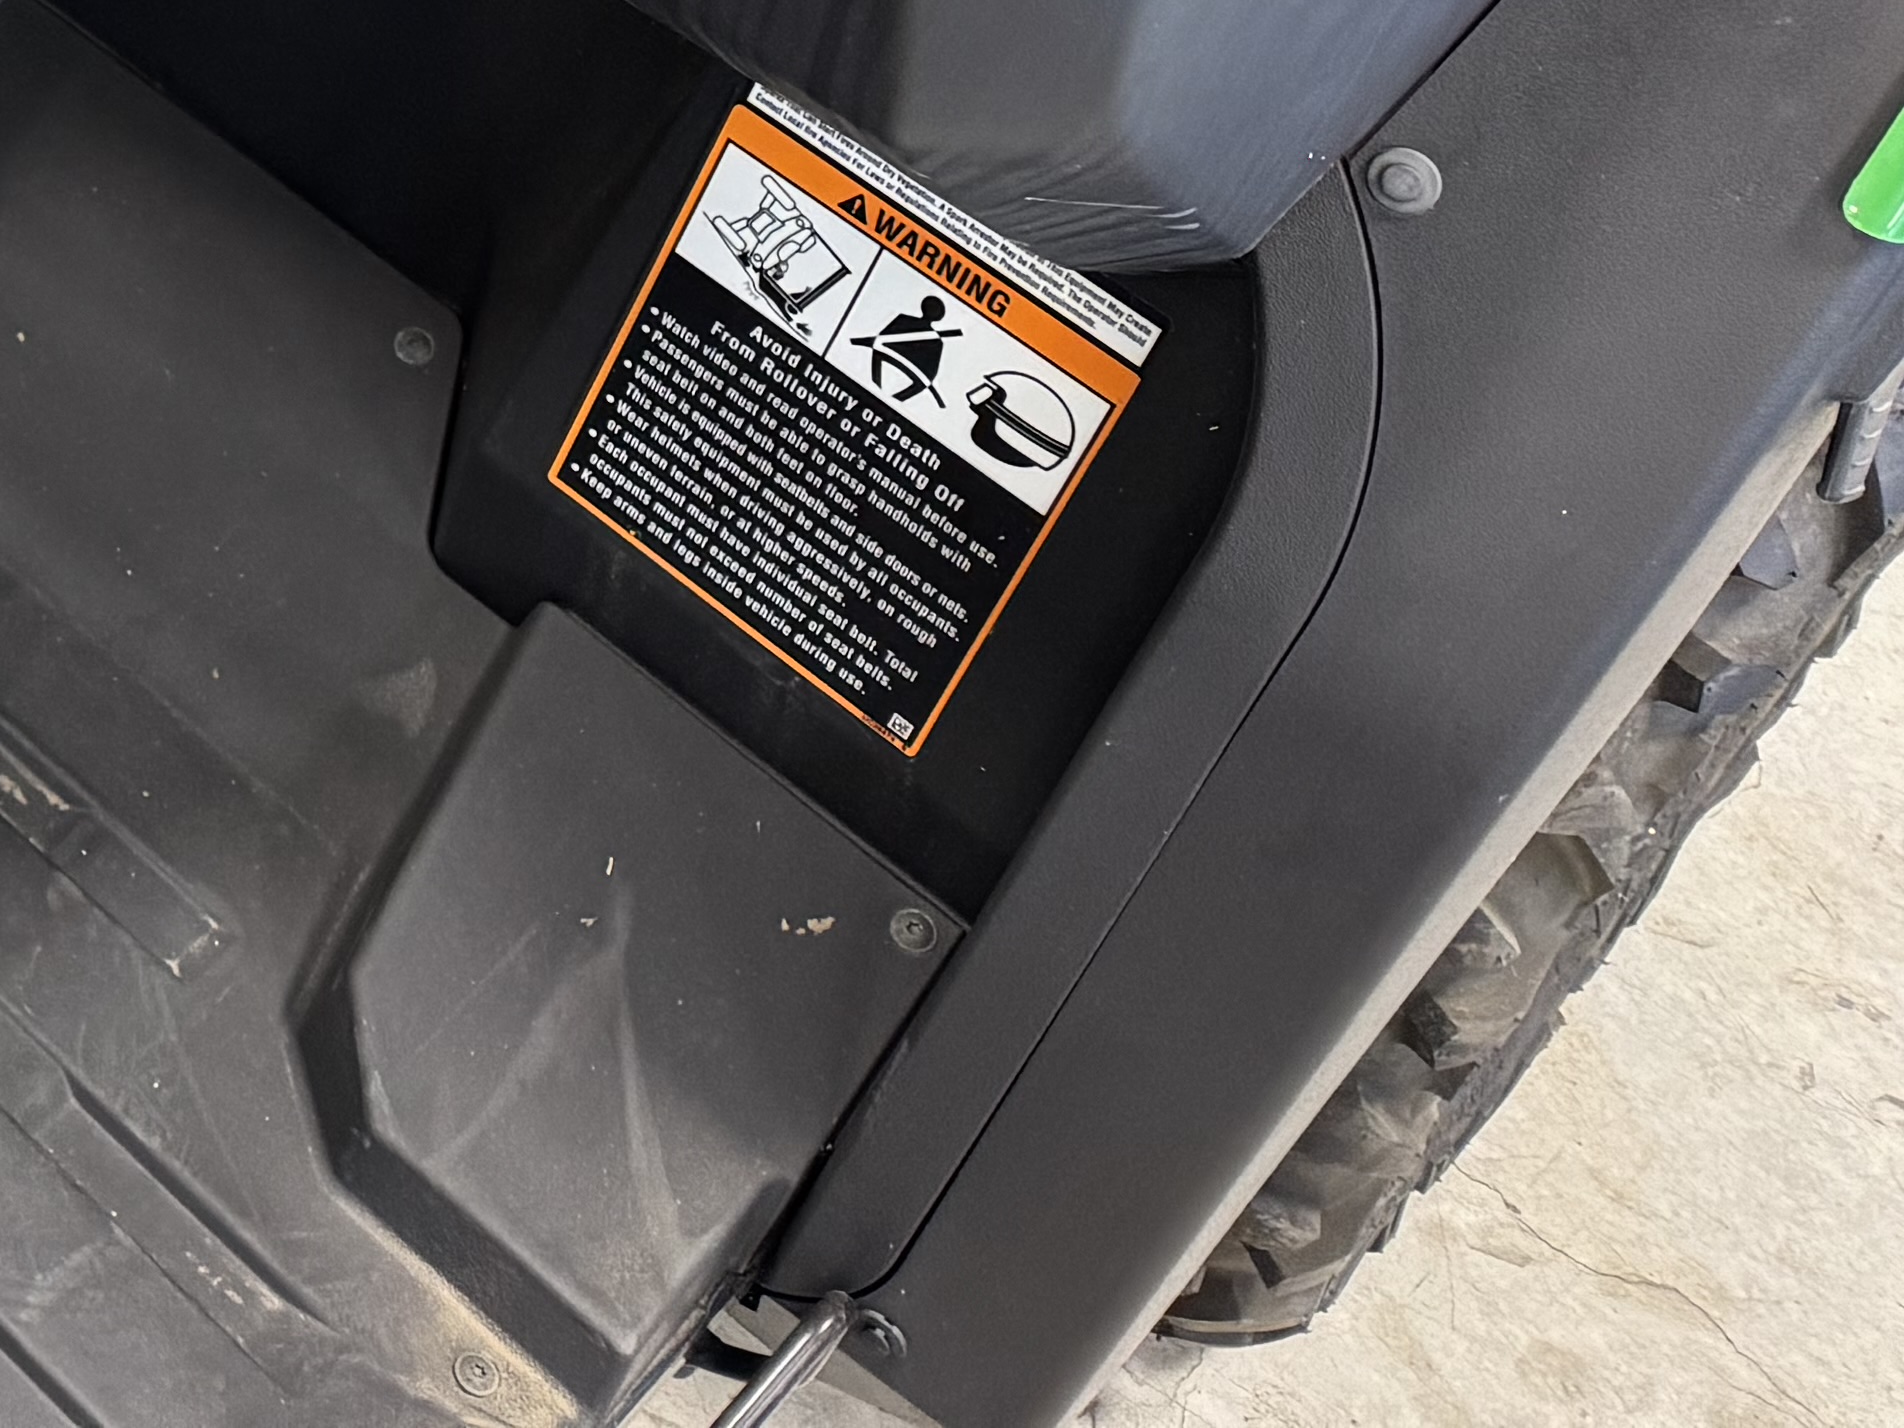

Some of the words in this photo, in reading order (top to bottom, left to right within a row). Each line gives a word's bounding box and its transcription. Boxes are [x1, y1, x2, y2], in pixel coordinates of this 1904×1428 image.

[875, 210, 1009, 316] WARNING
[642, 349, 671, 375] seat
[671, 369, 698, 396] belt
[699, 392, 716, 409] on
[718, 406, 745, 429] and
[745, 424, 774, 452] both
[776, 447, 804, 474] feet
[805, 470, 822, 488] on
[824, 483, 858, 516] floor.
[651, 330, 724, 390] Passengers
[725, 387, 759, 416] must
[760, 410, 777, 430] be
[779, 427, 809, 453] able
[811, 448, 826, 465] to
[827, 462, 865, 495] grasp
[868, 490, 938, 548] handholds
[940, 544, 971, 572] with
[661, 311, 700, 348] Watch
[702, 344, 738, 376] video
[739, 372, 766, 396] and
[766, 392, 799, 419] read
[799, 417, 866, 470] operator's
[868, 467, 921, 509] manual
[922, 504, 967, 543] before
[969, 540, 997, 567] use.
[677, 398, 691, 415] is
[691, 410, 747, 455] equipped
[747, 451, 773, 476] with
[774, 472, 830, 518] seatbelts
[830, 514, 856, 537] and
[855, 533, 883, 558] side
[884, 554, 921, 586] doors
[921, 582, 938, 597] or
[937, 593, 968, 622] nets.
[710, 321, 755, 362] From
[760, 357, 836, 418] Rollover
[840, 418, 861, 437] or
[864, 433, 929, 490] Falling
[934, 484, 964, 511] Off
[749, 326, 801, 368] Avoid
[804, 363, 858, 410] Injury
[861, 408, 883, 426] or
[886, 423, 940, 470] Death
[580, 468, 612, 499] Keep
[613, 495, 646, 524] arms
[647, 521, 673, 544] and
[673, 539, 701, 566] legs
[702, 561, 742, 598] inside
[745, 595, 791, 636] vehicle
[793, 633, 836, 672] during
[838, 667, 865, 694] use.
[589, 453, 651, 505] occupants
[652, 501, 685, 530] must
[685, 527, 708, 548] not
[709, 545, 756, 583] exceed
[756, 581, 806, 622] number
[807, 620, 824, 635] of
[823, 632, 854, 659] seat
[855, 654, 891, 690] belts.
[598, 434, 628, 464] Each
[629, 461, 685, 507] occupant
[686, 503, 719, 532] must
[719, 526, 750, 556] have
[752, 551, 817, 606] individual
[817, 603, 848, 630] seat
[848, 624, 877, 655] belt.
[884, 649, 918, 682] Total
[606, 419, 622, 434] or
[623, 431, 668, 470] uneven
[670, 465, 714, 508] terrain,
[720, 505, 735, 520] or
[736, 517, 752, 533] at
[752, 527, 795, 565] higher
[796, 563, 845, 606] speeds.
[616, 399, 649, 431] Wear
[650, 426, 701, 471] helmets
[703, 467, 737, 498] when
[739, 495, 785, 536] driving
[786, 531, 870, 601] aggressively,
[877, 598, 895, 617] on
[897, 614, 936, 647] rough
[626, 382, 652, 410] This
[653, 406, 692, 441] safety
[693, 437, 760, 490] equipment
[761, 487, 795, 517] must
[795, 510, 813, 531] be
[814, 528, 848, 556] used
[848, 551, 866, 571] by
[867, 567, 888, 586] all
[889, 583, 959, 641] occupants.
